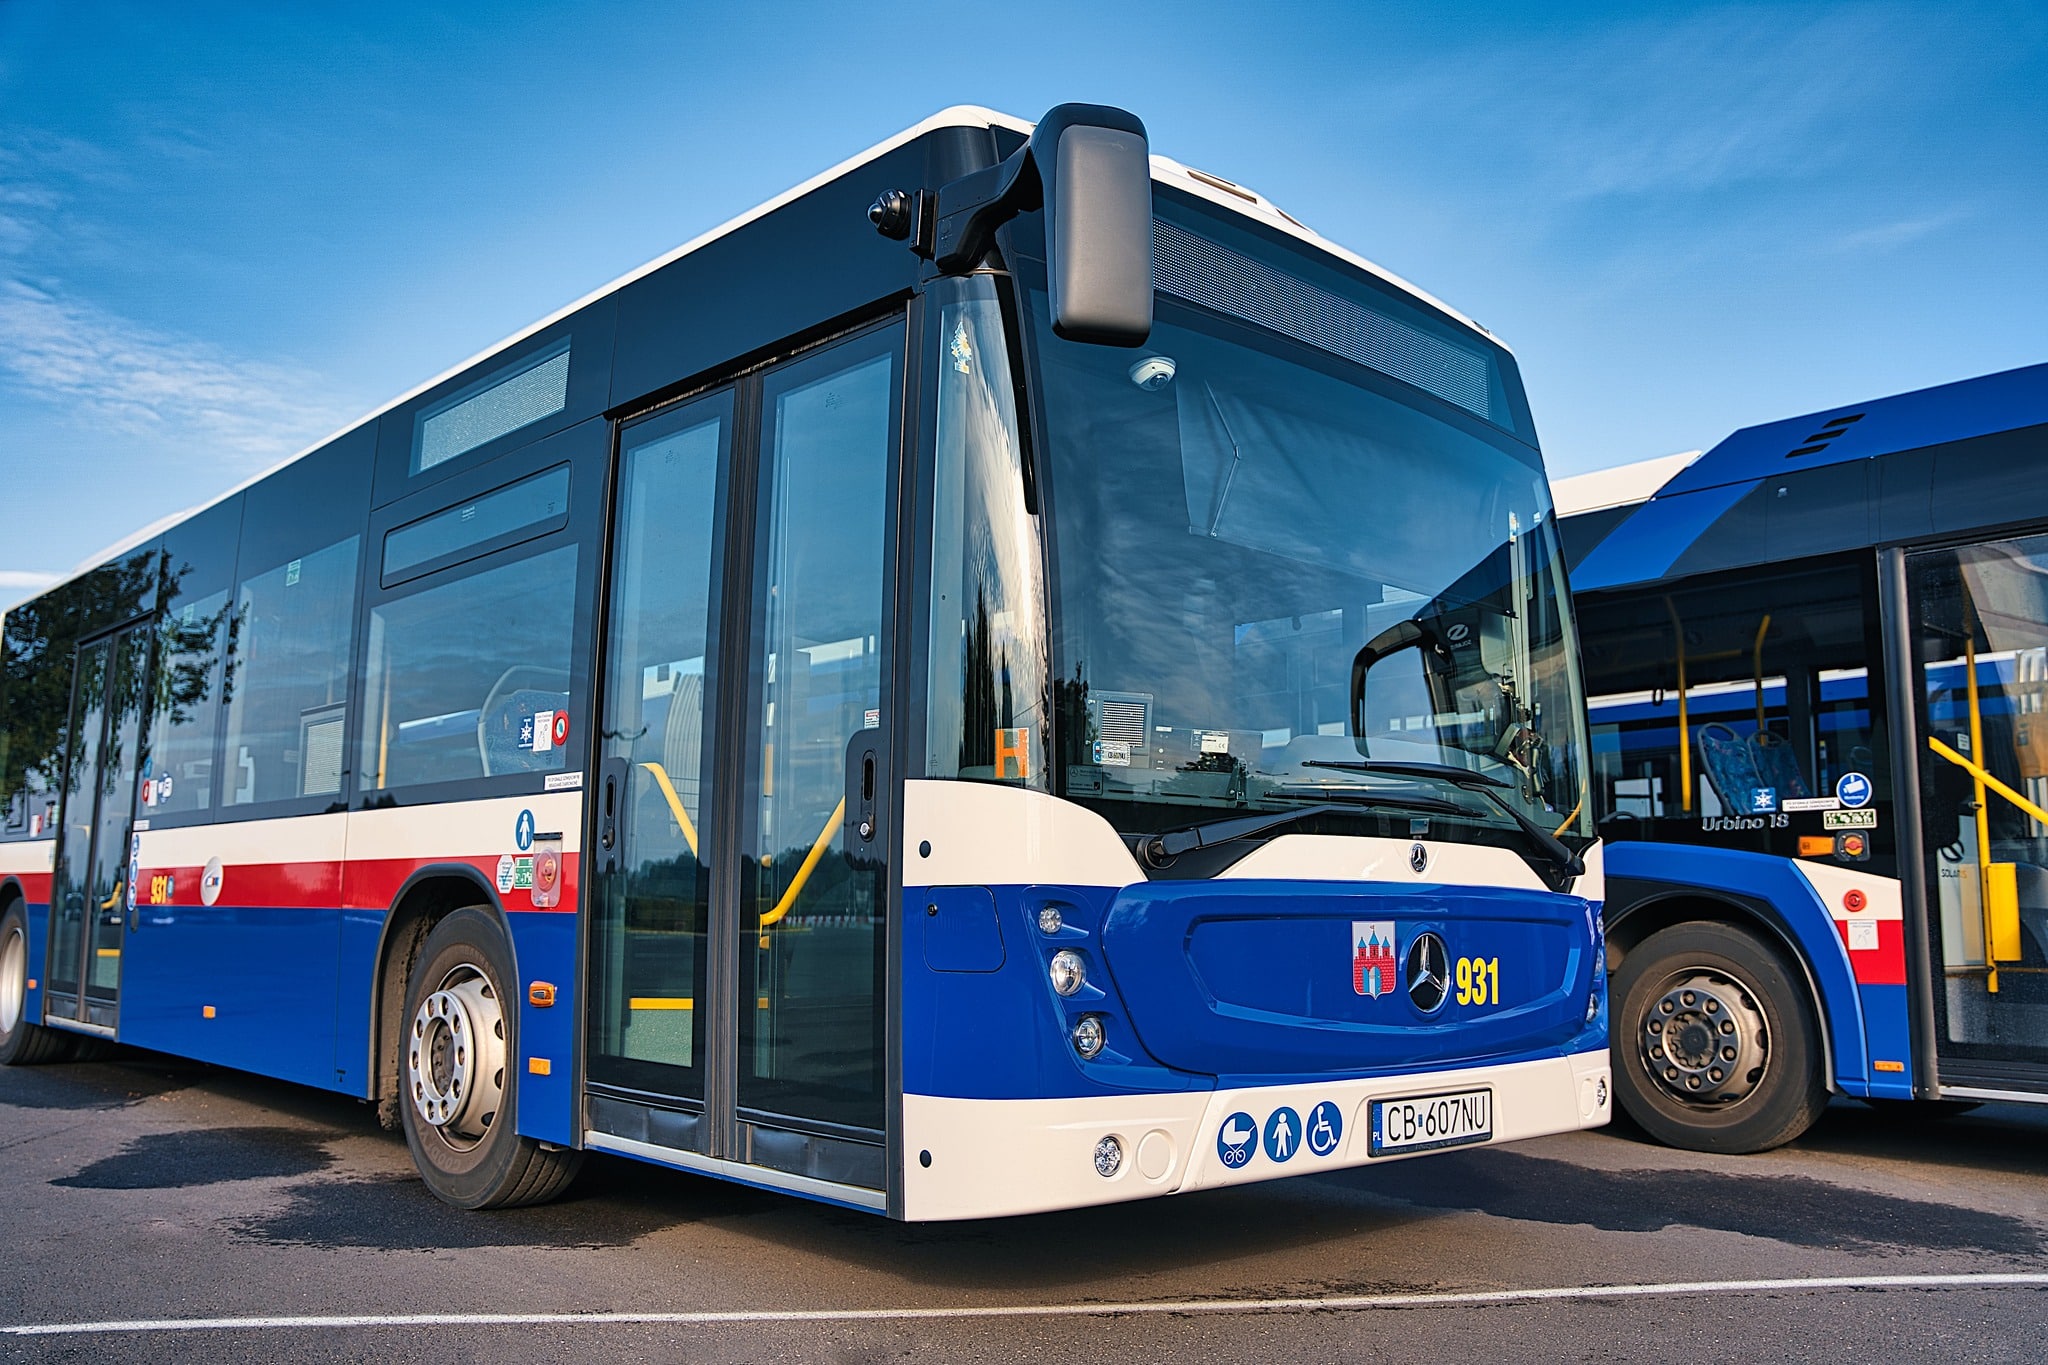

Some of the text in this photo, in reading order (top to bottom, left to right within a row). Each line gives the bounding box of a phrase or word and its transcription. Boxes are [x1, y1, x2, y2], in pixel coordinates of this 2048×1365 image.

[995, 728, 1028, 778] H
[1702, 813, 1790, 831] Urbino 18
[150, 875, 168, 904] 931
[1456, 956, 1499, 1006] 931
[1372, 1131, 1382, 1142] PL
[1388, 1095, 1485, 1142] CB 607NU
